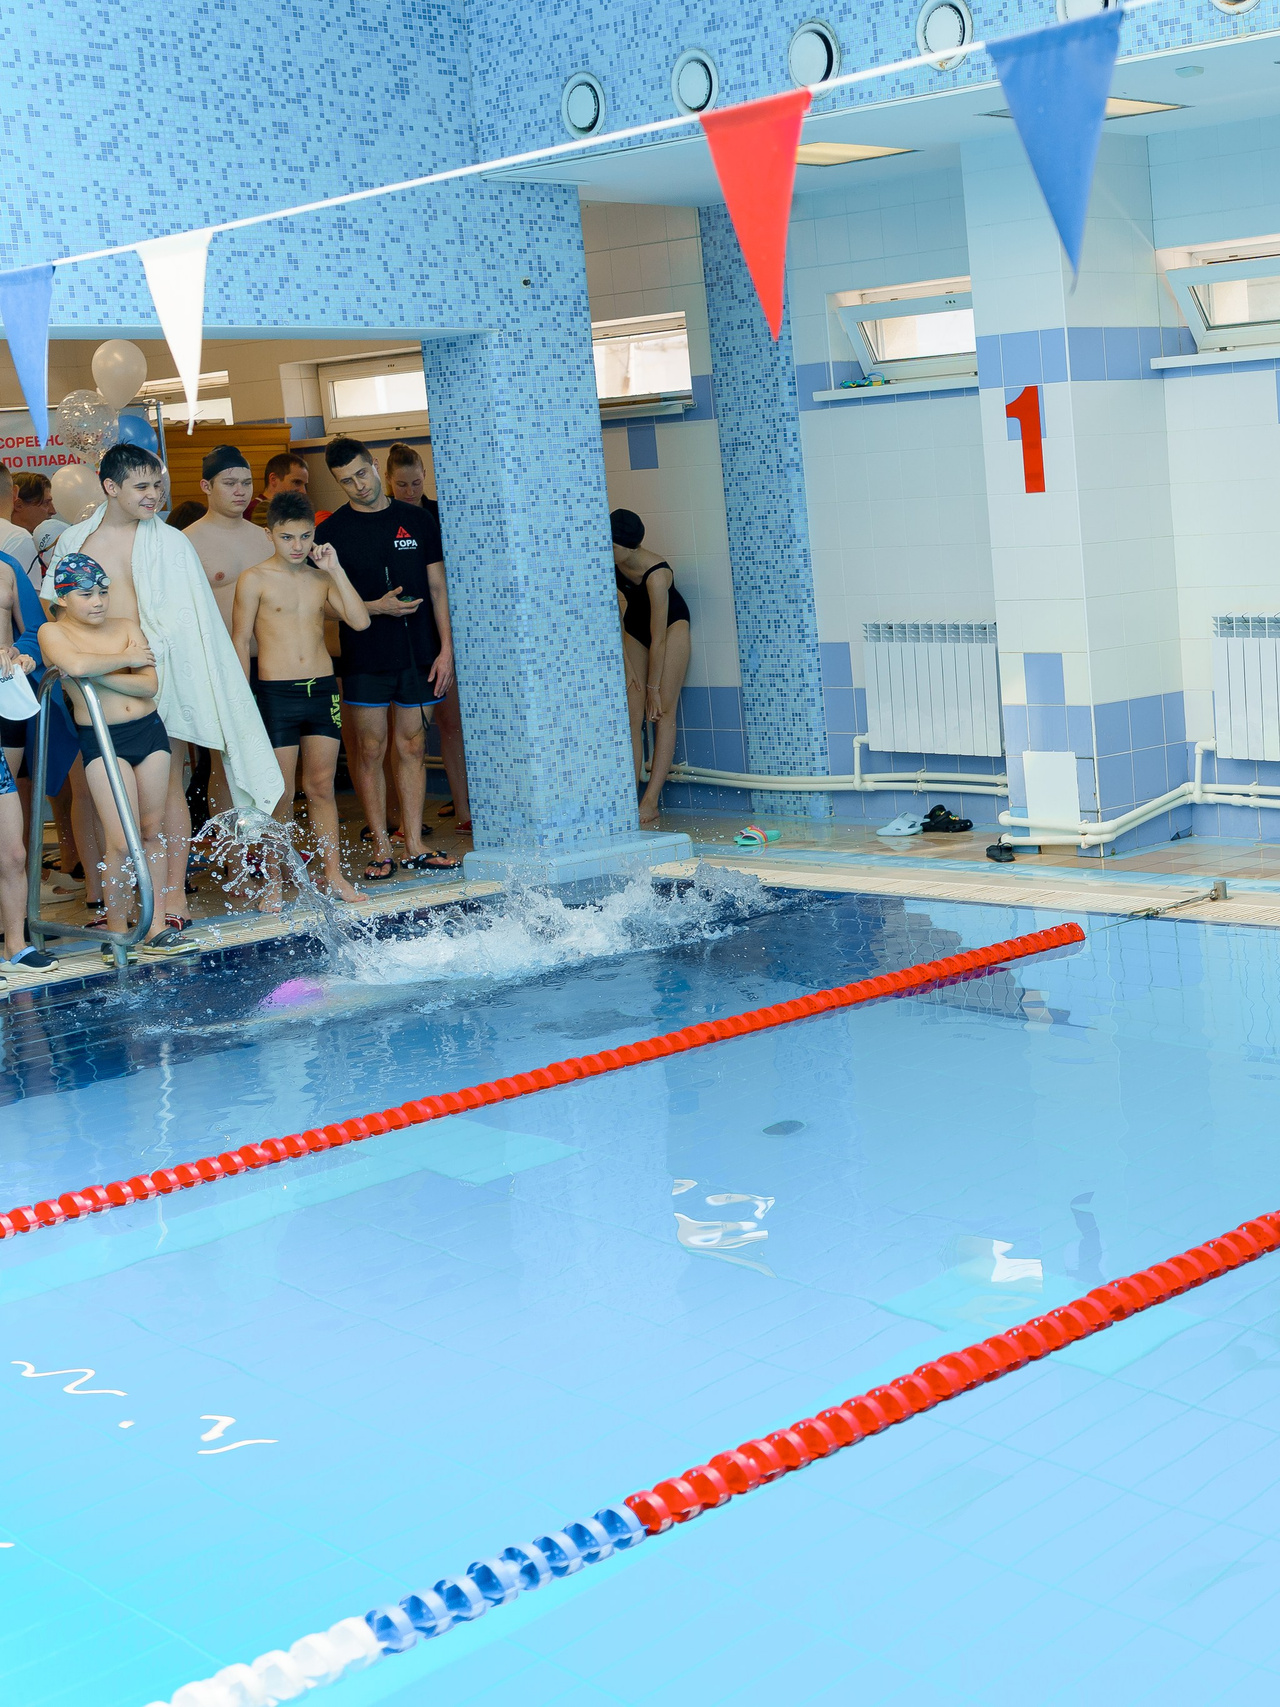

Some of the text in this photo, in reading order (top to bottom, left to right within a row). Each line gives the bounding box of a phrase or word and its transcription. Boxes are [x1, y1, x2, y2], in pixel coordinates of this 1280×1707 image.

[1005, 385, 1046, 494] 1
[2, 456, 23, 468] ПО
[394, 539, 418, 548] ГОРА
